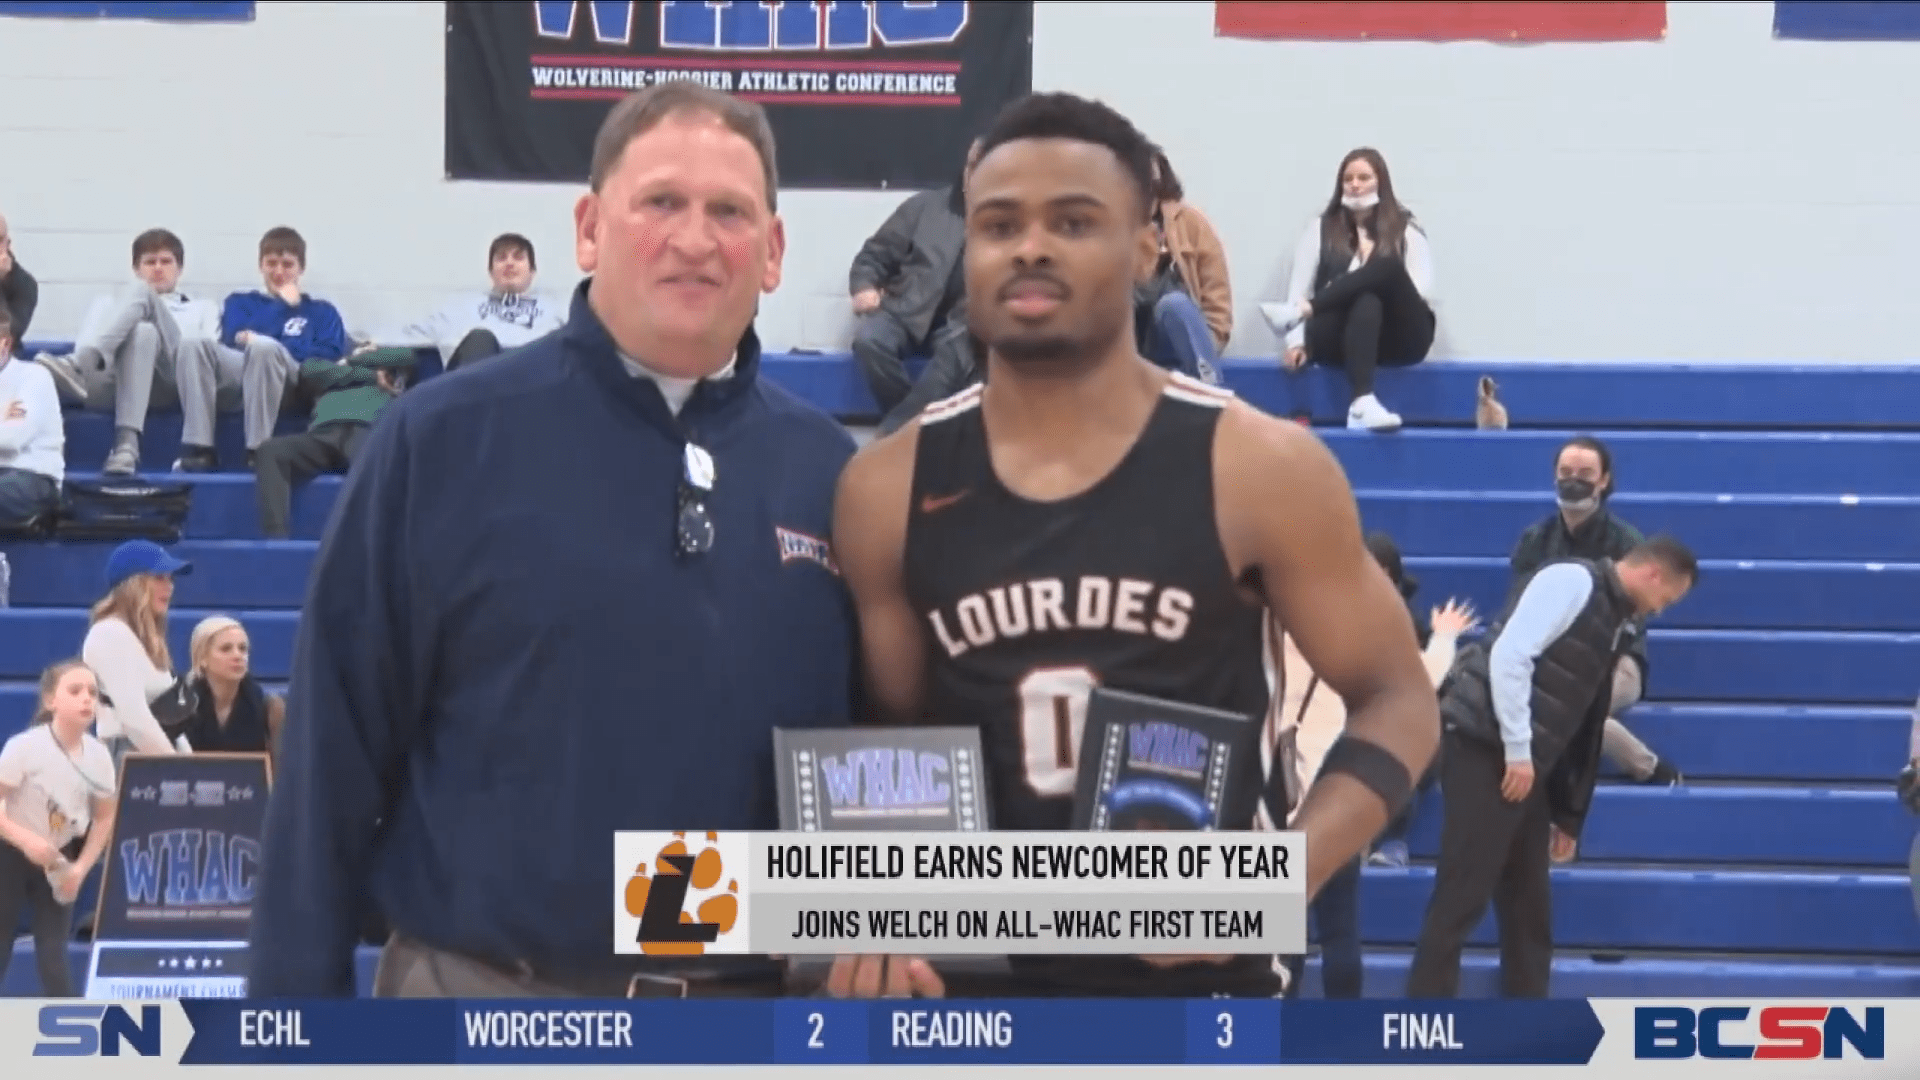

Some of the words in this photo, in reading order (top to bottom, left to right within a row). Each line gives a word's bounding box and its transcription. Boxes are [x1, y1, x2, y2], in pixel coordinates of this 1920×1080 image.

[738, 72, 830, 92] ATHLETIC
[835, 73, 957, 94] CONFERENCE
[928, 576, 1194, 657] LOURDES
[1019, 667, 1098, 796] 0
[121, 828, 261, 905] WHAC
